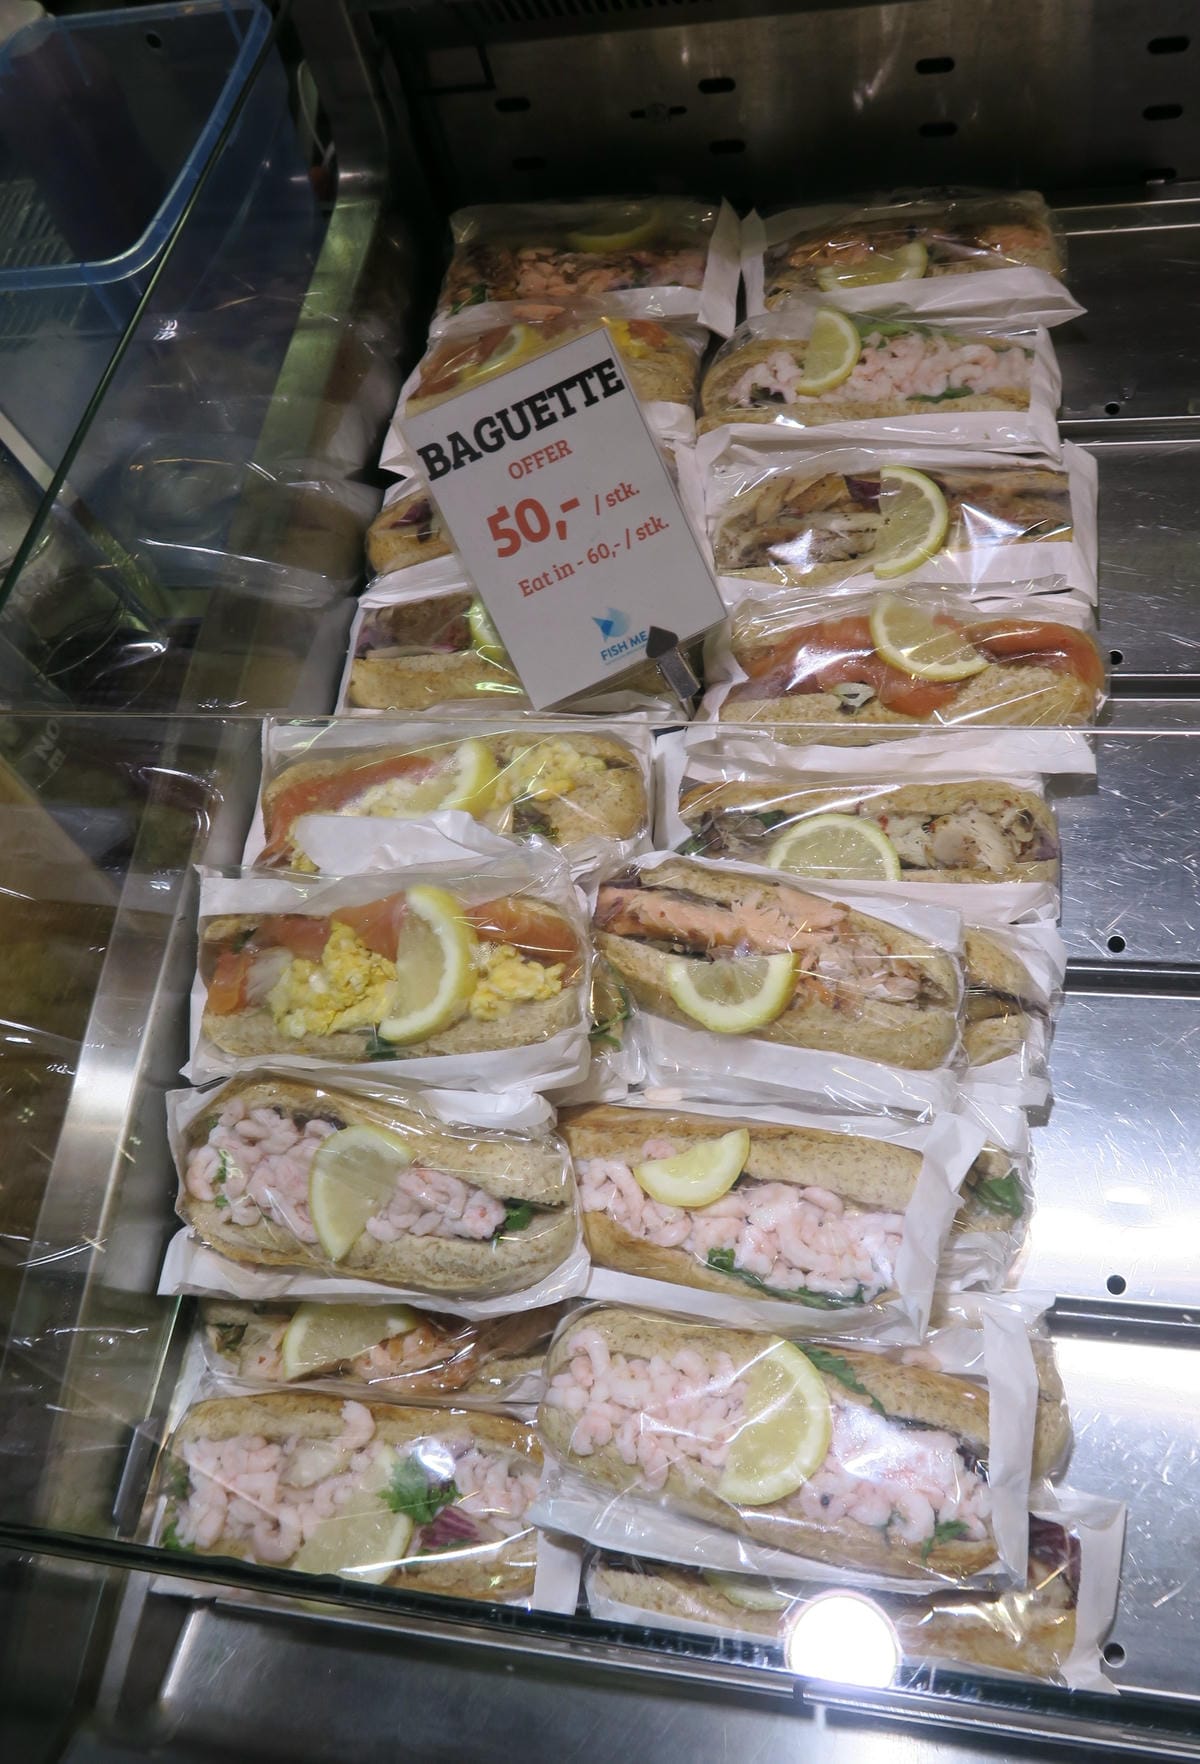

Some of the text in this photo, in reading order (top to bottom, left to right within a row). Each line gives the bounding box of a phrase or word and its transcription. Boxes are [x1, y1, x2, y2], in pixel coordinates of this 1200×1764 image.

[416, 357, 626, 481] BAGUETTE
[508, 439, 573, 480] OFFER
[486, 497, 581, 558] 50,-
[605, 482, 641, 508] stk.
[518, 571, 554, 597] Eat
[552, 560, 575, 581] in
[586, 542, 621, 564] 60,-
[635, 516, 670, 541] stk.
[600, 641, 629, 661] FISH
[630, 630, 649, 648] ME
